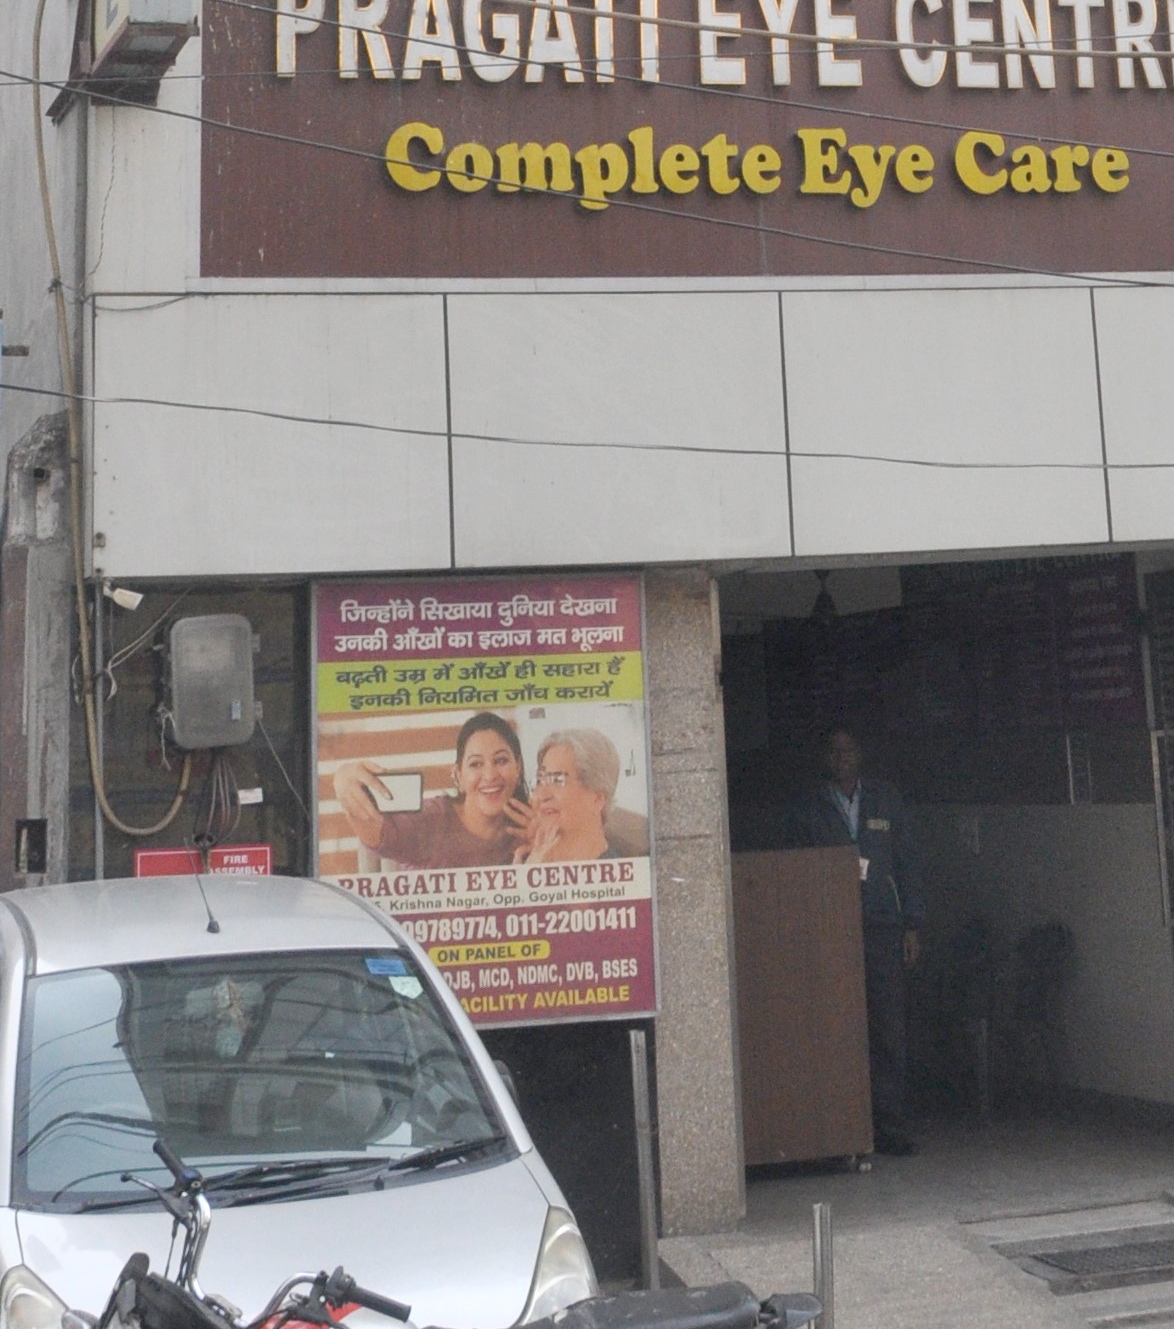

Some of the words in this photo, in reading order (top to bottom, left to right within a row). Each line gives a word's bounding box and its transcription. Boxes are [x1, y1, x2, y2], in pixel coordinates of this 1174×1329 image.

[386, 122, 782, 210] Complete
[798, 127, 934, 209] Eye
[955, 131, 1131, 196] Care
[340, 599, 415, 623] जिन्होंने
[420, 597, 492, 621] सिखाया
[497, 595, 556, 626] दुनिया
[559, 593, 618, 616] देखना
[334, 627, 388, 652] उनकी
[393, 626, 446, 651] आँखों
[447, 631, 474, 648] का
[477, 629, 532, 650] इलाज
[536, 628, 567, 645] मत
[571, 626, 624, 652] भूलना
[393, 668, 426, 684] उम्र
[433, 663, 454, 680] में
[458, 660, 511, 680] आँखें
[514, 659, 536, 679] ही
[542, 662, 601, 677] सहारा
[606, 655, 626, 675] हैं
[349, 688, 411, 710] इनकी
[418, 685, 499, 705] नियमित
[503, 683, 549, 702] जाँच
[555, 680, 614, 700] करायें
[223, 854, 248, 864] FIRE
[338, 870, 457, 898] PRAGATI
[466, 868, 518, 892] EYE
[526, 861, 635, 888] CENTRE
[389, 899, 442, 911] Krishna
[446, 895, 489, 910] Nagar,
[493, 893, 524, 907] Opp.
[528, 890, 568, 904] Goyal
[571, 886, 625, 901] Hospital
[506, 906, 636, 936] 011-22001411
[437, 947, 460, 963] ON
[466, 944, 515, 960] PANEL
[520, 943, 541, 957] OF
[479, 967, 513, 990] MCD,
[517, 964, 562, 986] NDMC,
[566, 961, 598, 983] DVB,
[602, 958, 638, 978] BSES
[461, 993, 528, 1013] ACILITY
[534, 985, 630, 1008] AVAILABLE
